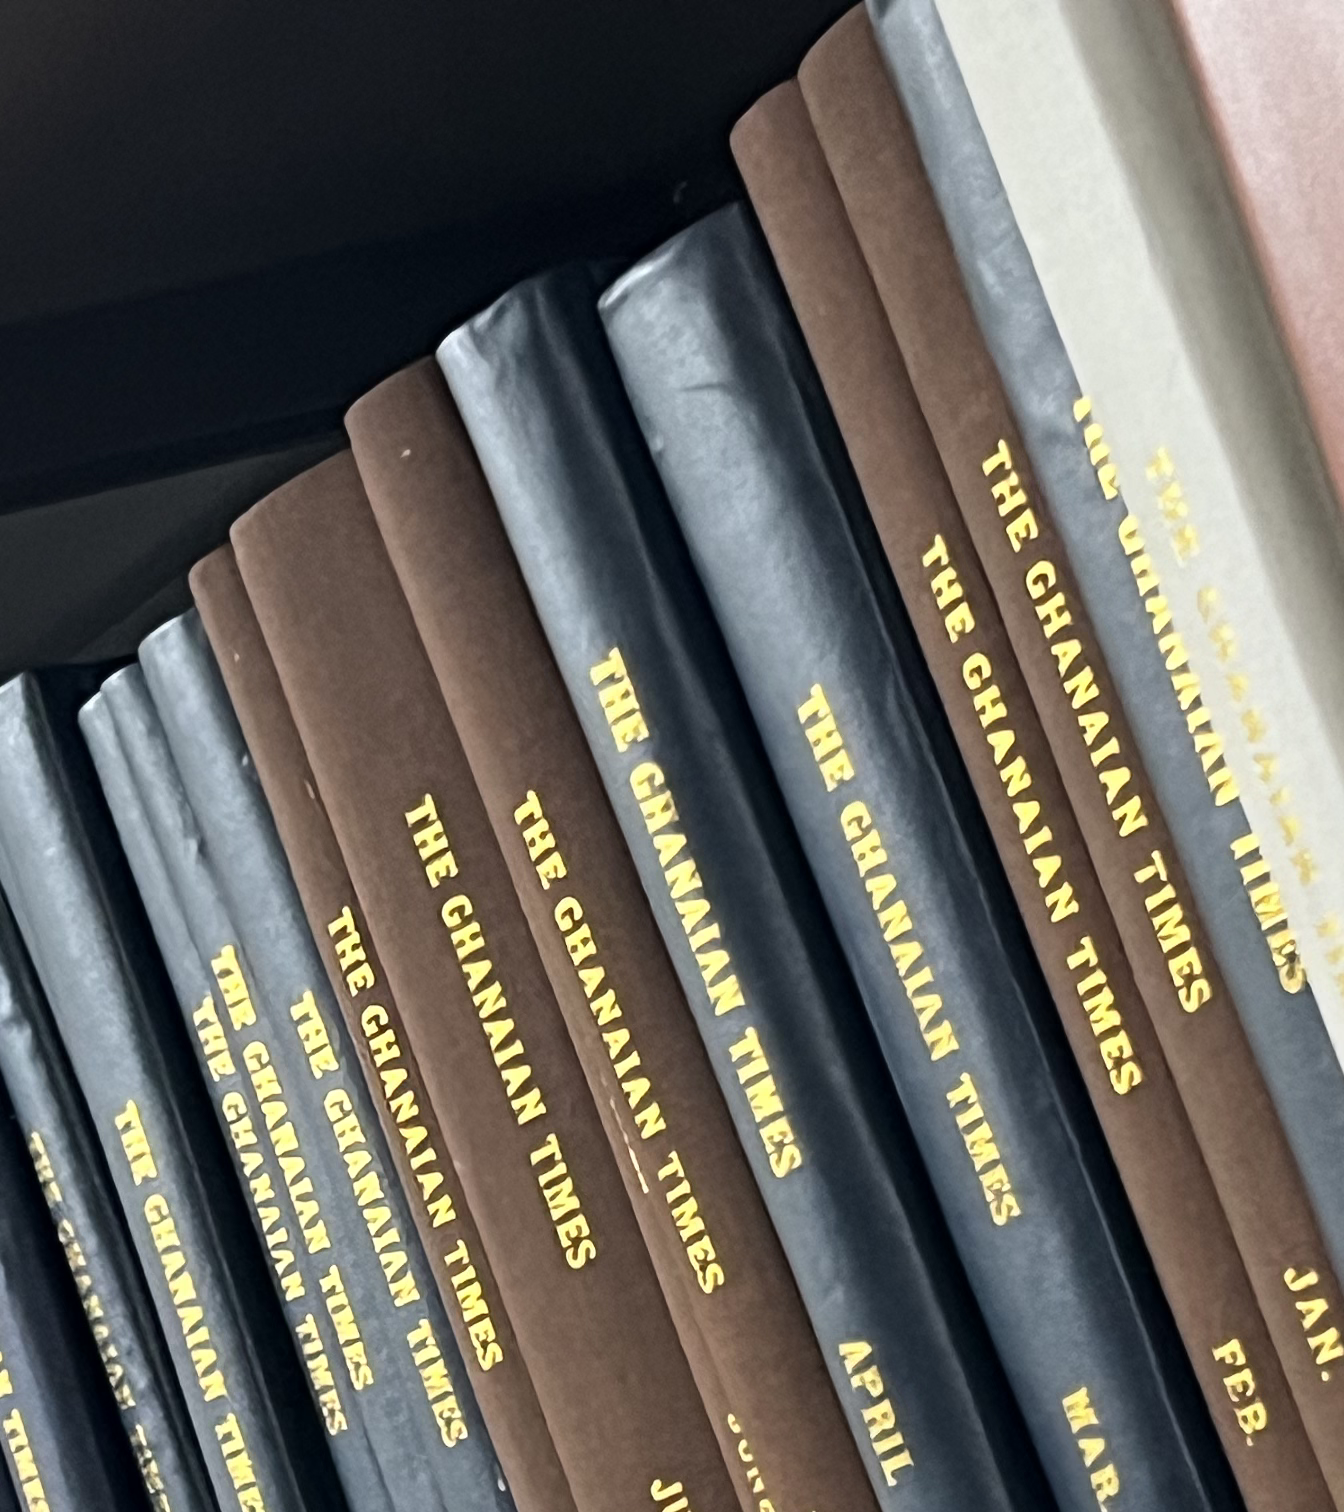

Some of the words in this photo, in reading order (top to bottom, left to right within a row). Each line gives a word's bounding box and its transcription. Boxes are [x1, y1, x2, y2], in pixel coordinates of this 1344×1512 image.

[797, 682, 857, 794] THE
[839, 800, 961, 1062] GHANAIAN
[945, 1071, 1023, 1229] TIMES
[981, 438, 1040, 553] THE
[1025, 558, 1149, 839] GHANAIAN
[1133, 848, 1214, 1016] TIMES
[192, 992, 237, 1083] THE
[221, 1090, 307, 1302] GHANAIAN
[295, 1313, 349, 1436] TIMES
[210, 944, 258, 1031] THE
[242, 1039, 332, 1254] GHANAIAN
[319, 1263, 375, 1391] TIMES
[289, 989, 341, 1080] THE
[323, 1088, 422, 1309] GHANAIAN
[405, 1318, 470, 1448] TIMES
[327, 905, 377, 998] THE
[360, 1003, 458, 1229] GHANAIAN
[443, 1238, 505, 1373] TIMES
[403, 791, 460, 889] THE
[440, 894, 547, 1127] GHANAIAN
[529, 1132, 598, 1271] TIMES
[513, 789, 569, 891] THE
[553, 895, 668, 1141] GHANAIAN
[655, 1150, 726, 1296] TIMES
[589, 646, 651, 754] THE
[629, 762, 748, 1018] GHANAIAN
[727, 1025, 804, 1181] TIMES
[838, 1338, 916, 1488] APRIL
[920, 533, 977, 645] THE
[961, 651, 1081, 925] GHANAIAN
[1065, 935, 1145, 1097] TIMES
[1211, 1336, 1269, 1447] FEB.
[114, 1099, 158, 1186] THE
[144, 1193, 228, 1402] GHANAIAN
